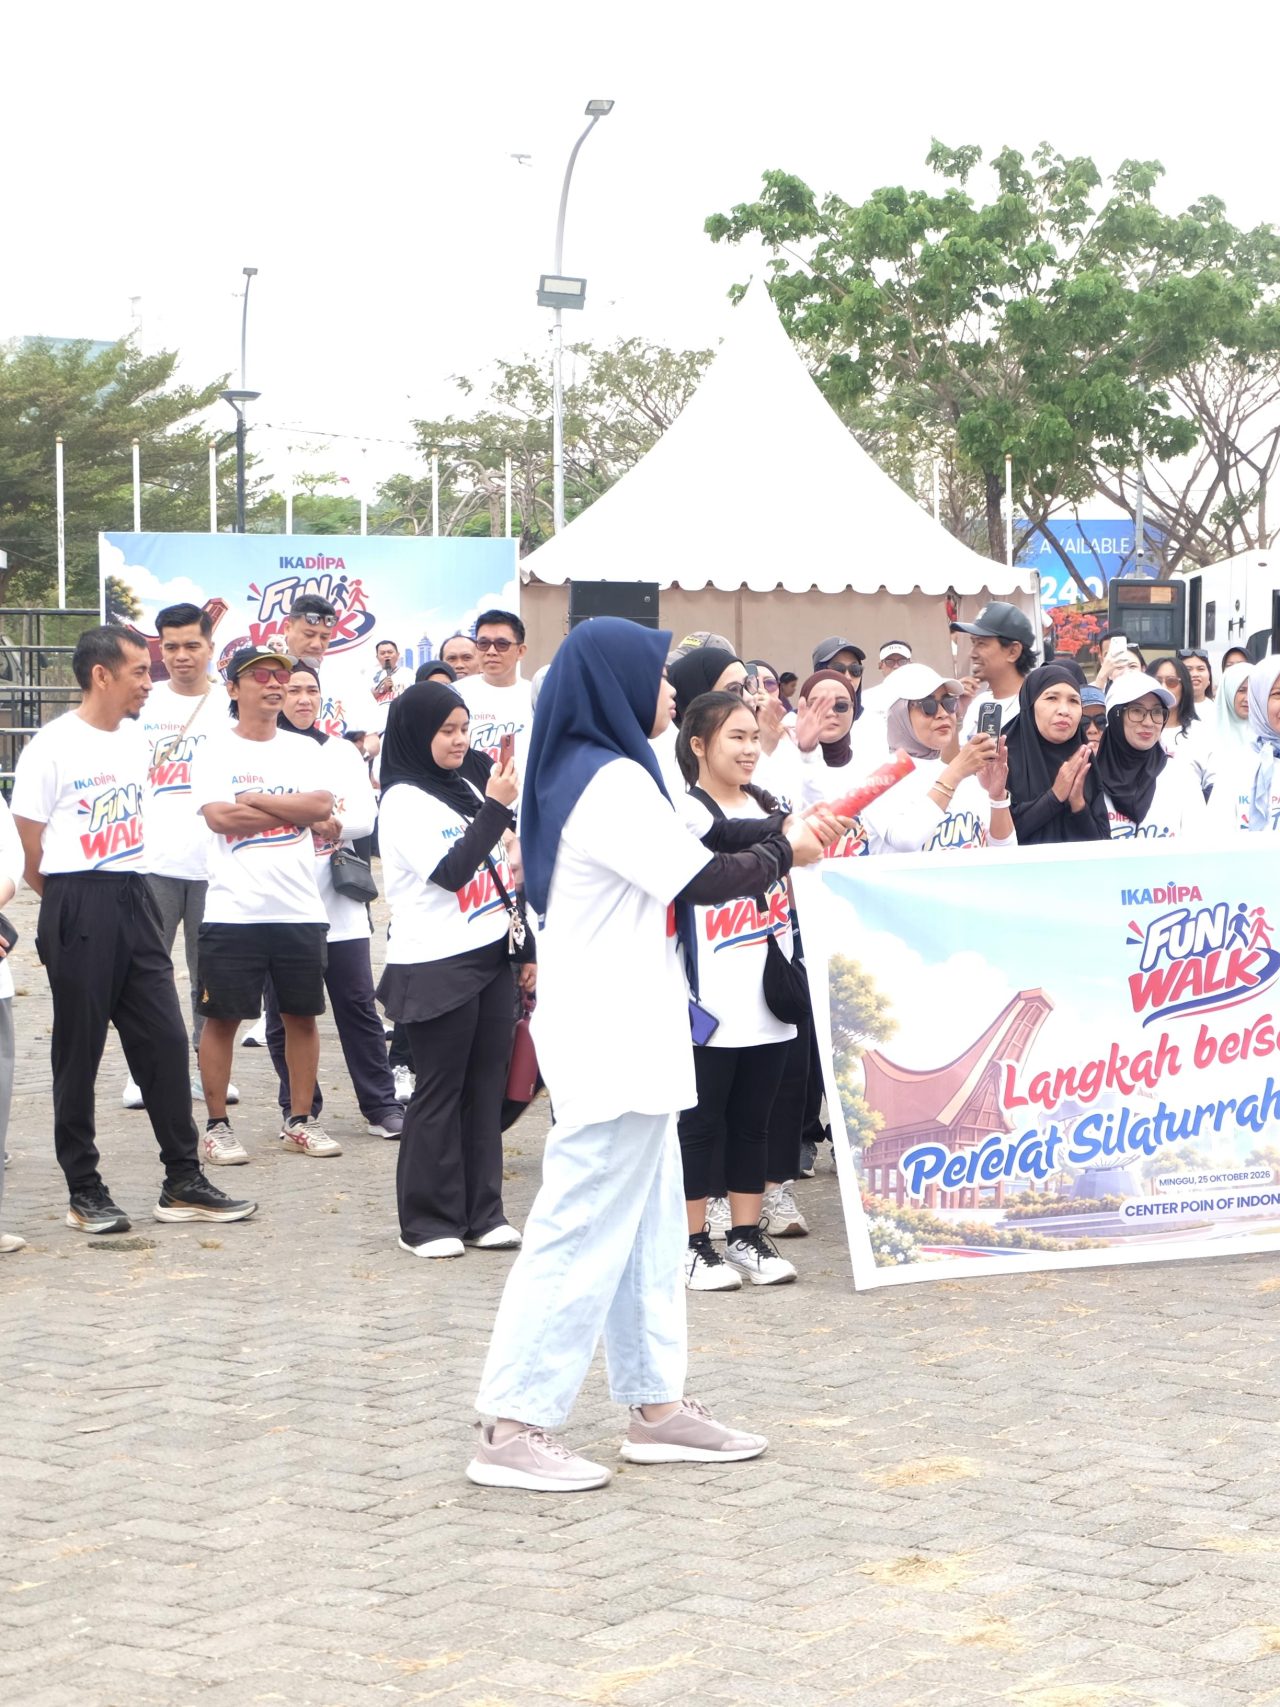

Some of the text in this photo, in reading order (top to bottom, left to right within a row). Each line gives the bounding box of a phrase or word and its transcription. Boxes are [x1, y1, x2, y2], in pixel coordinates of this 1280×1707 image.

[88, 783, 138, 833] FUN
[1139, 902, 1229, 973] FUN
[1128, 948, 1262, 1013] WALK
[1004, 1032, 1182, 1110] Langkah
[903, 1125, 1063, 1194] Pererat
[1159, 1171, 1271, 1187] MINGGU, 25 OKTOBER 2026
[1125, 1201, 1178, 1218] CENTER
[1181, 1199, 1214, 1214] POIN
[1216, 1197, 1235, 1210] OF
